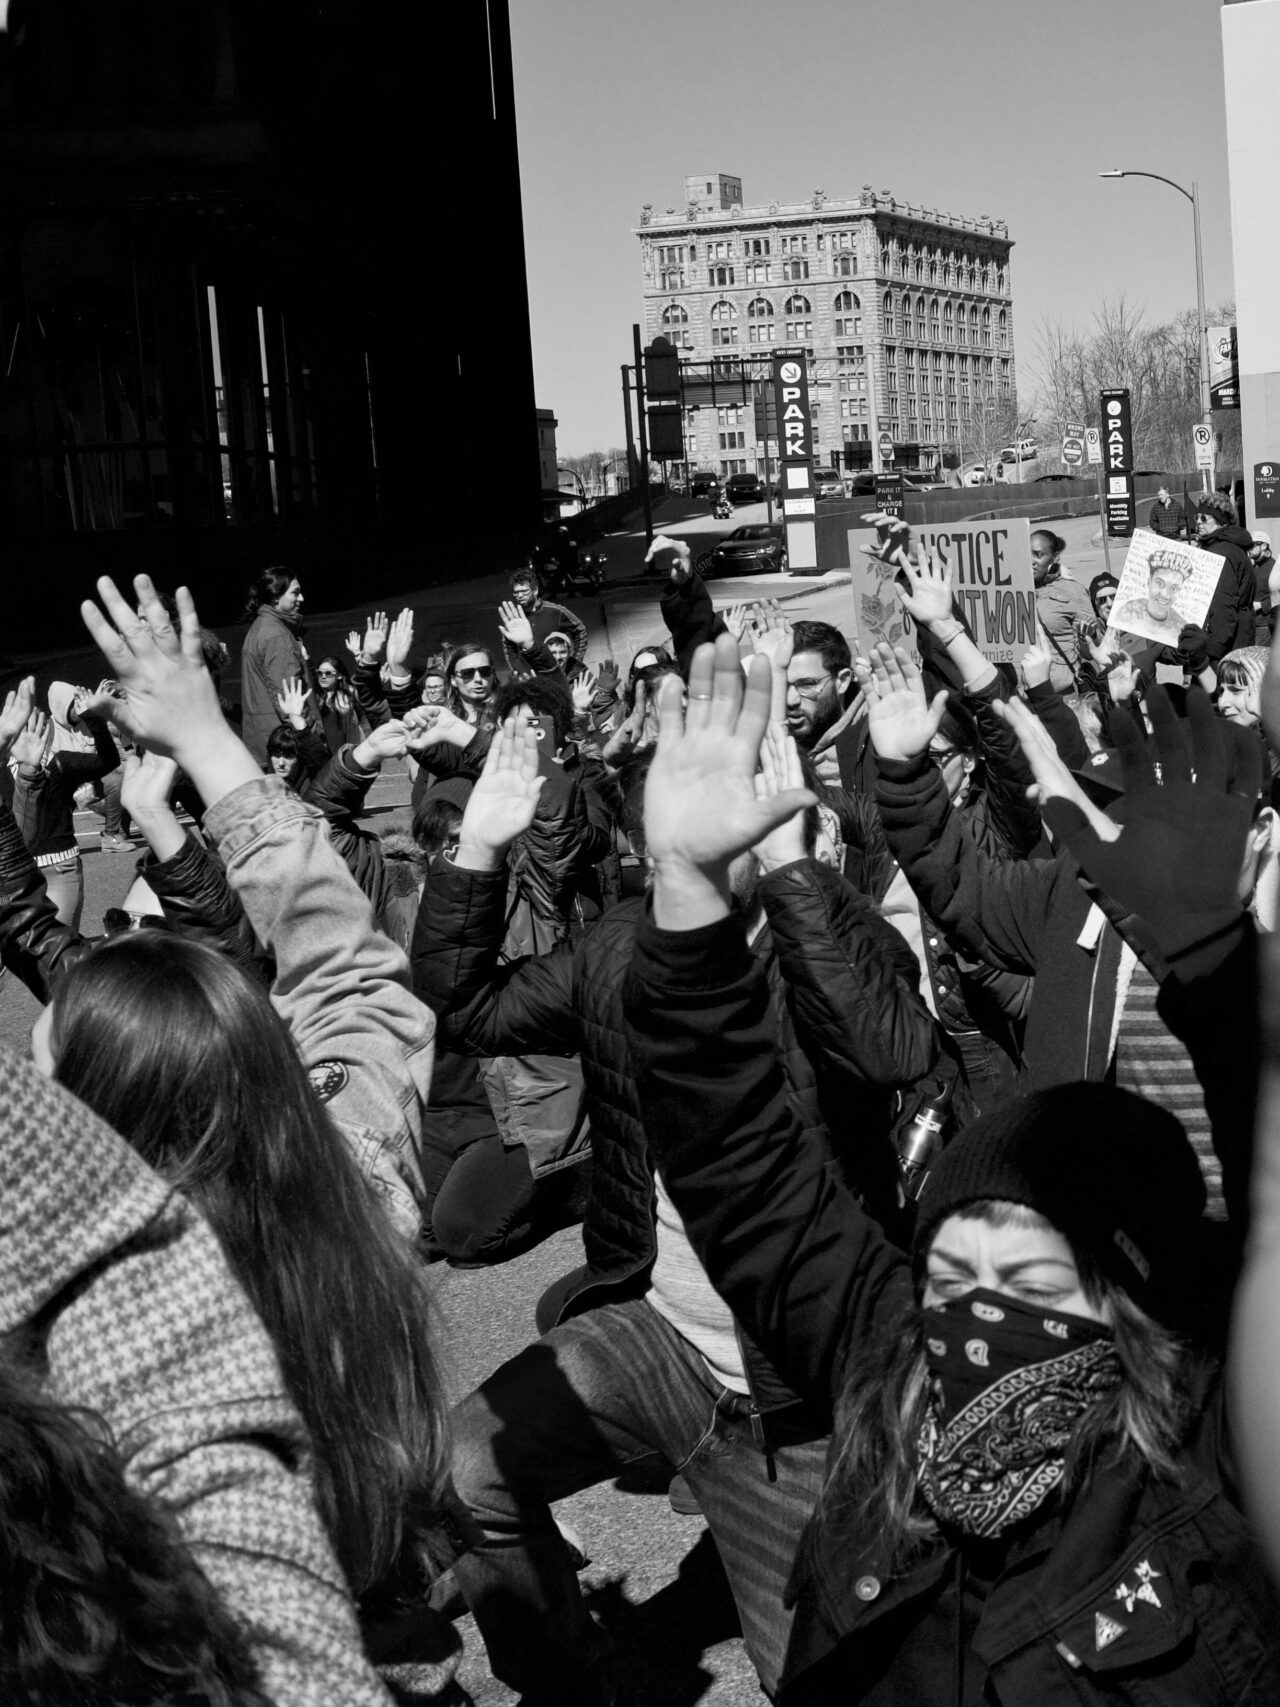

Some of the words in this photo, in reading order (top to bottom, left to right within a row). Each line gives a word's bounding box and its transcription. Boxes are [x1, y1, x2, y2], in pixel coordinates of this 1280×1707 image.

[782, 387, 806, 456] PARK
[1108, 419, 1125, 469] PARK
[920, 529, 1012, 586] STICE
